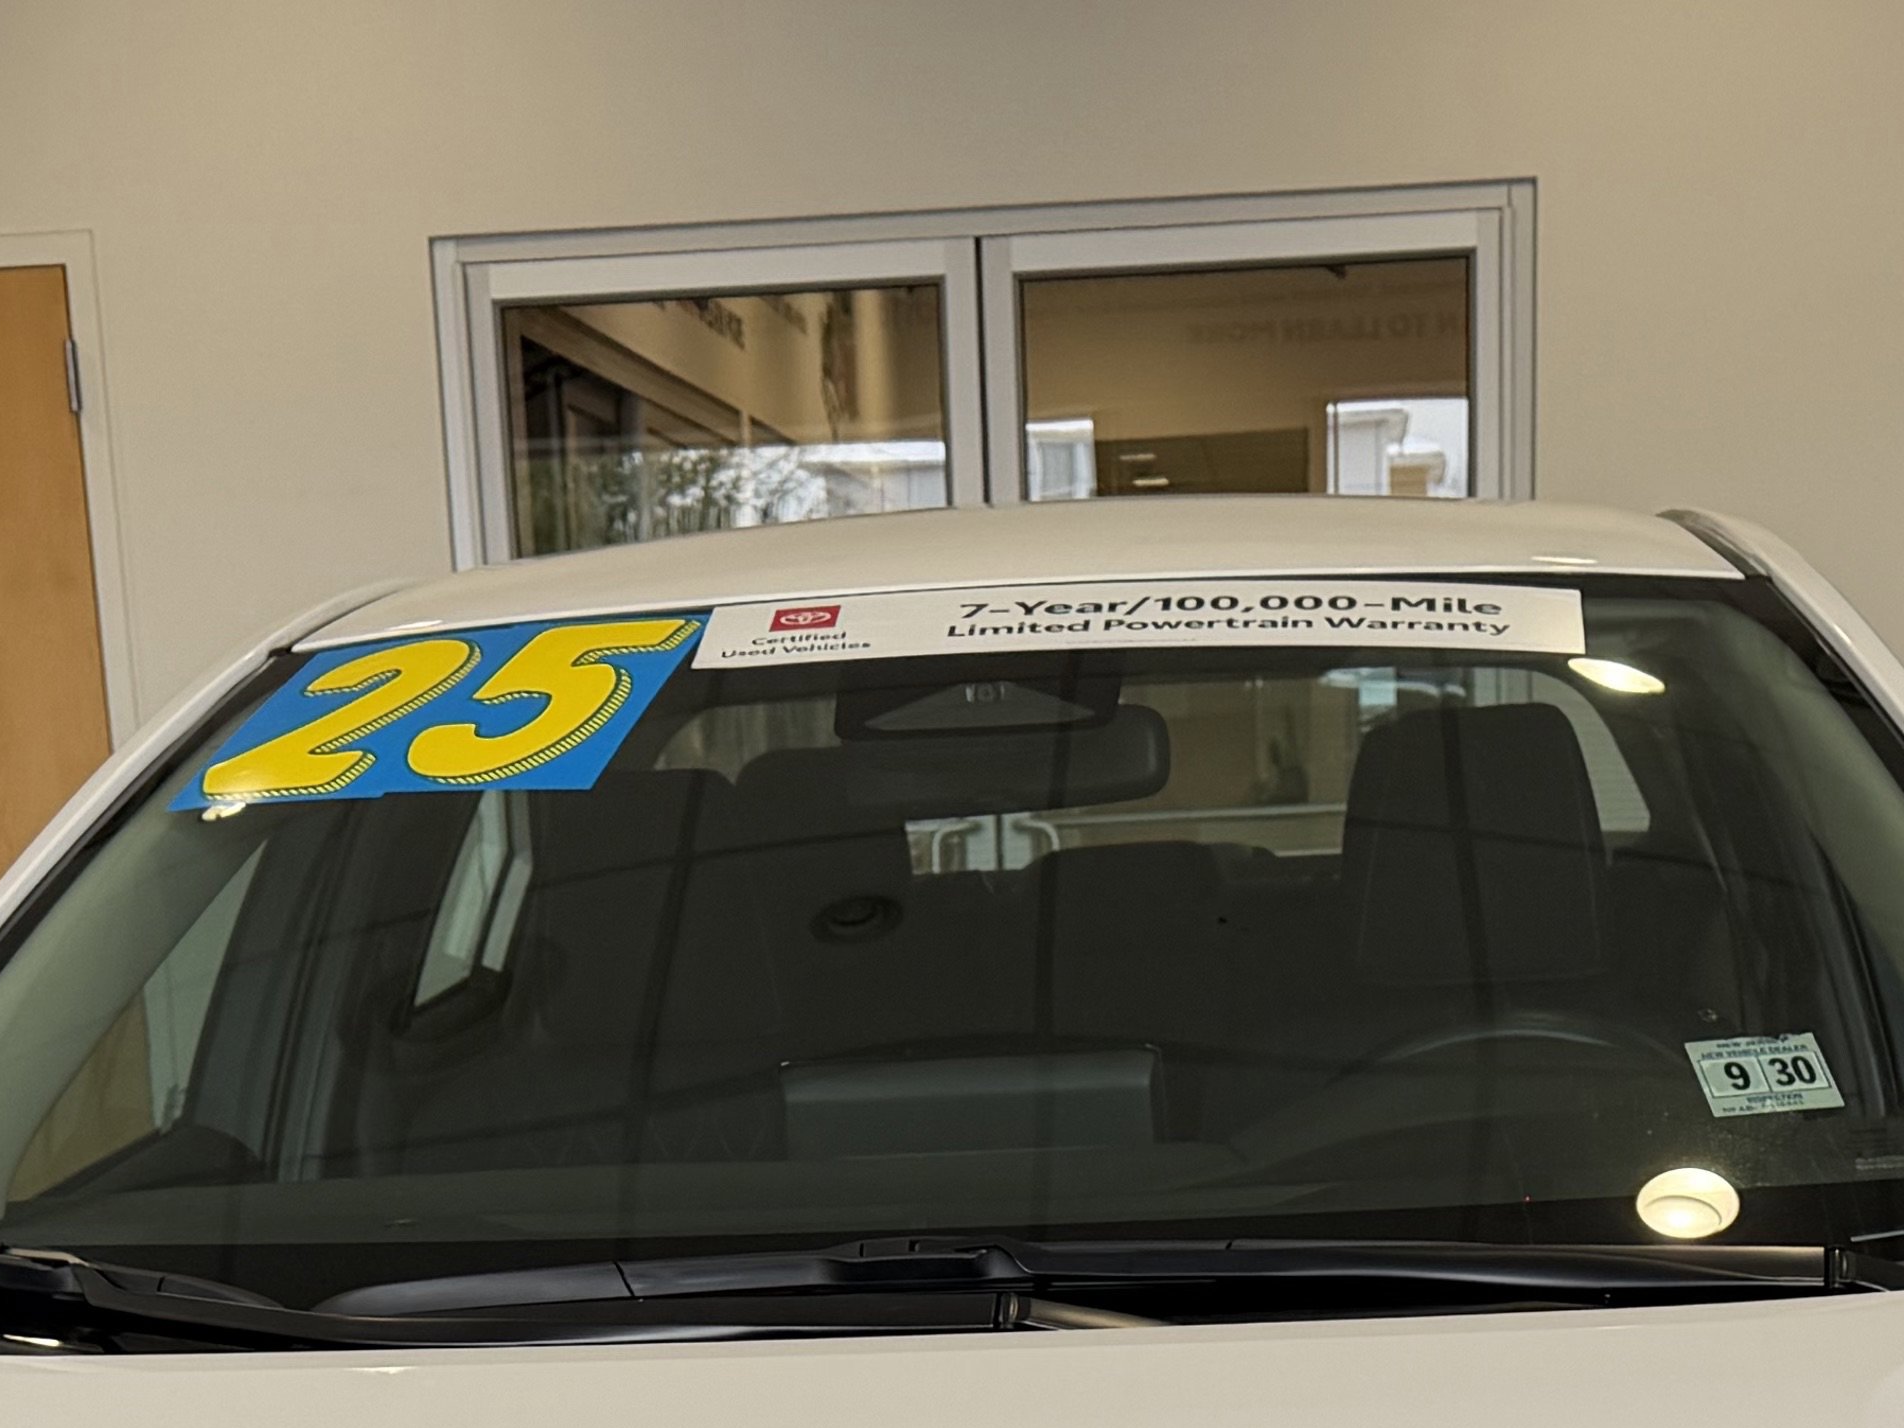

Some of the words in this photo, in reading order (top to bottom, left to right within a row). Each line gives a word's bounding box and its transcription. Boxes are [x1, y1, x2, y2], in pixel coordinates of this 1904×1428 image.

[948, 619, 1091, 637] Limited
[1103, 616, 1314, 632] Powertrain
[1324, 616, 1510, 636] Warranty
[752, 631, 846, 645] Certified
[721, 647, 776, 658] Used
[783, 642, 871, 653] Vehicles
[202, 619, 701, 800] 25
[1724, 1062, 1751, 1090] 9
[1768, 1056, 1816, 1086] 30
